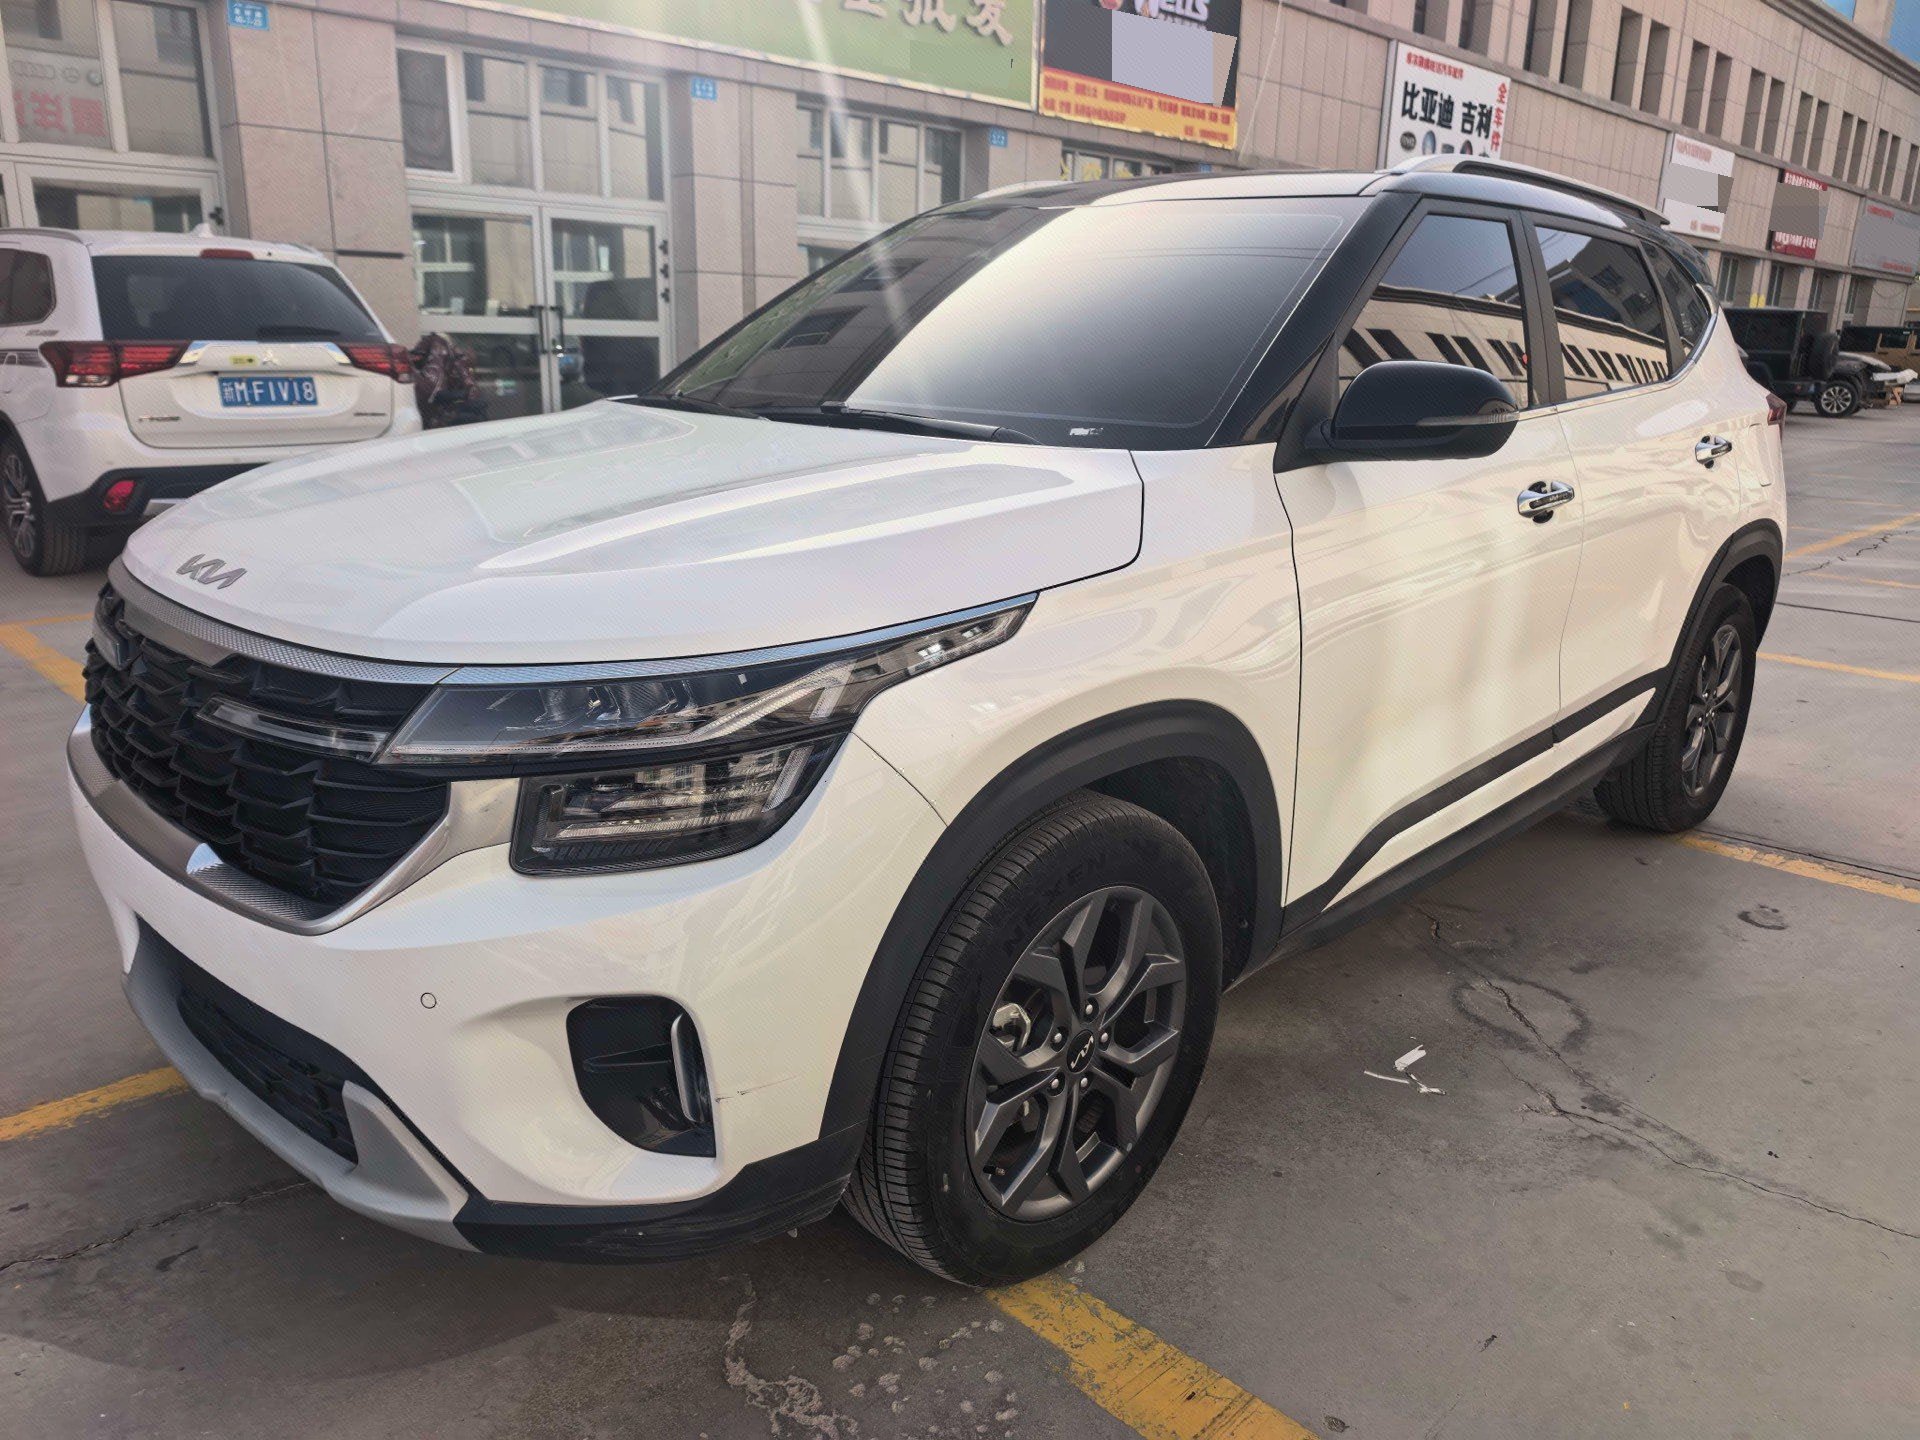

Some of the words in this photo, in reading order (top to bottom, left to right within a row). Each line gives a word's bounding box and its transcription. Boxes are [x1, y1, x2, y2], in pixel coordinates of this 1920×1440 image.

[1401, 81, 1455, 130] 比亚迪
[1461, 100, 1493, 139] 吉利
[176, 553, 247, 590] KIA
